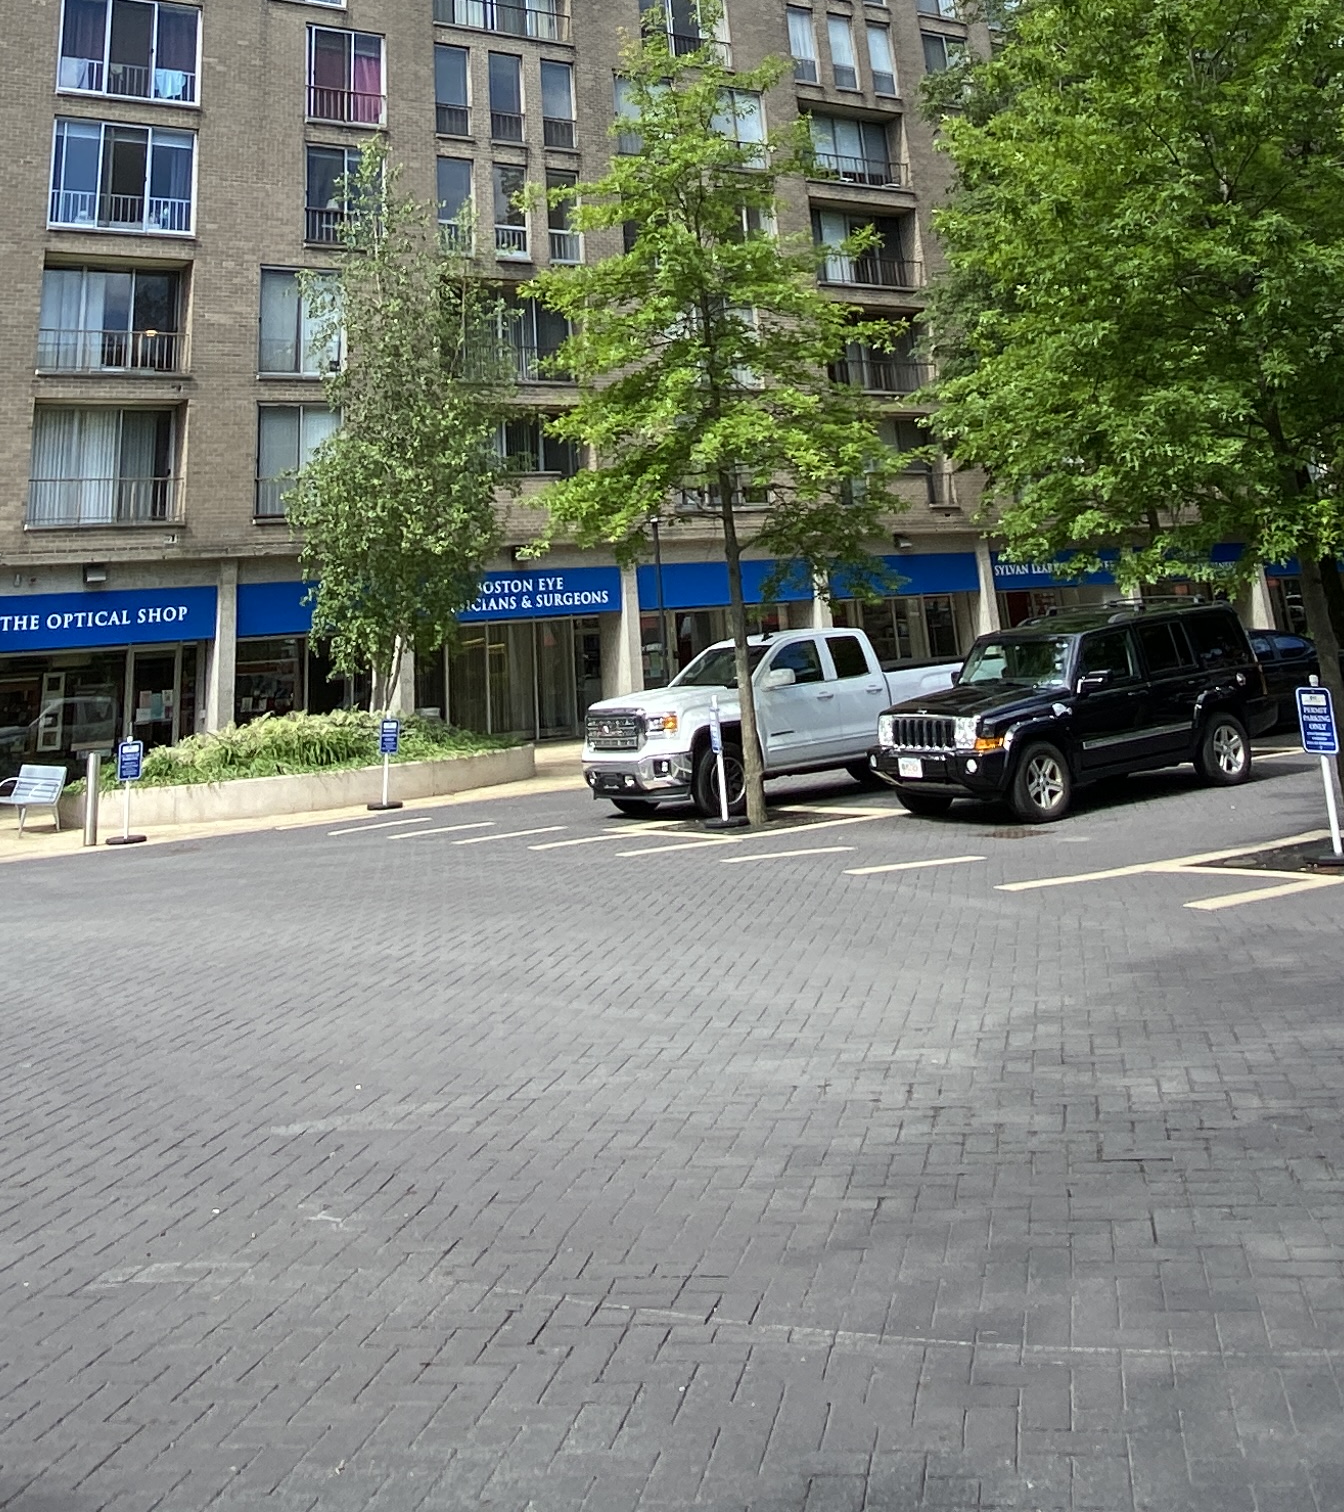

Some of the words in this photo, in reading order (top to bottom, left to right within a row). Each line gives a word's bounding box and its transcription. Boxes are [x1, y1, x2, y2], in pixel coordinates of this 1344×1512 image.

[994, 564, 1029, 576] SYLVAN
[538, 576, 564, 591] EYE
[521, 595, 532, 609] &
[536, 590, 609, 607] SURGEONS
[0, 614, 40, 632] THE
[46, 609, 131, 630] OPTICAL
[137, 605, 188, 624] SHOP
